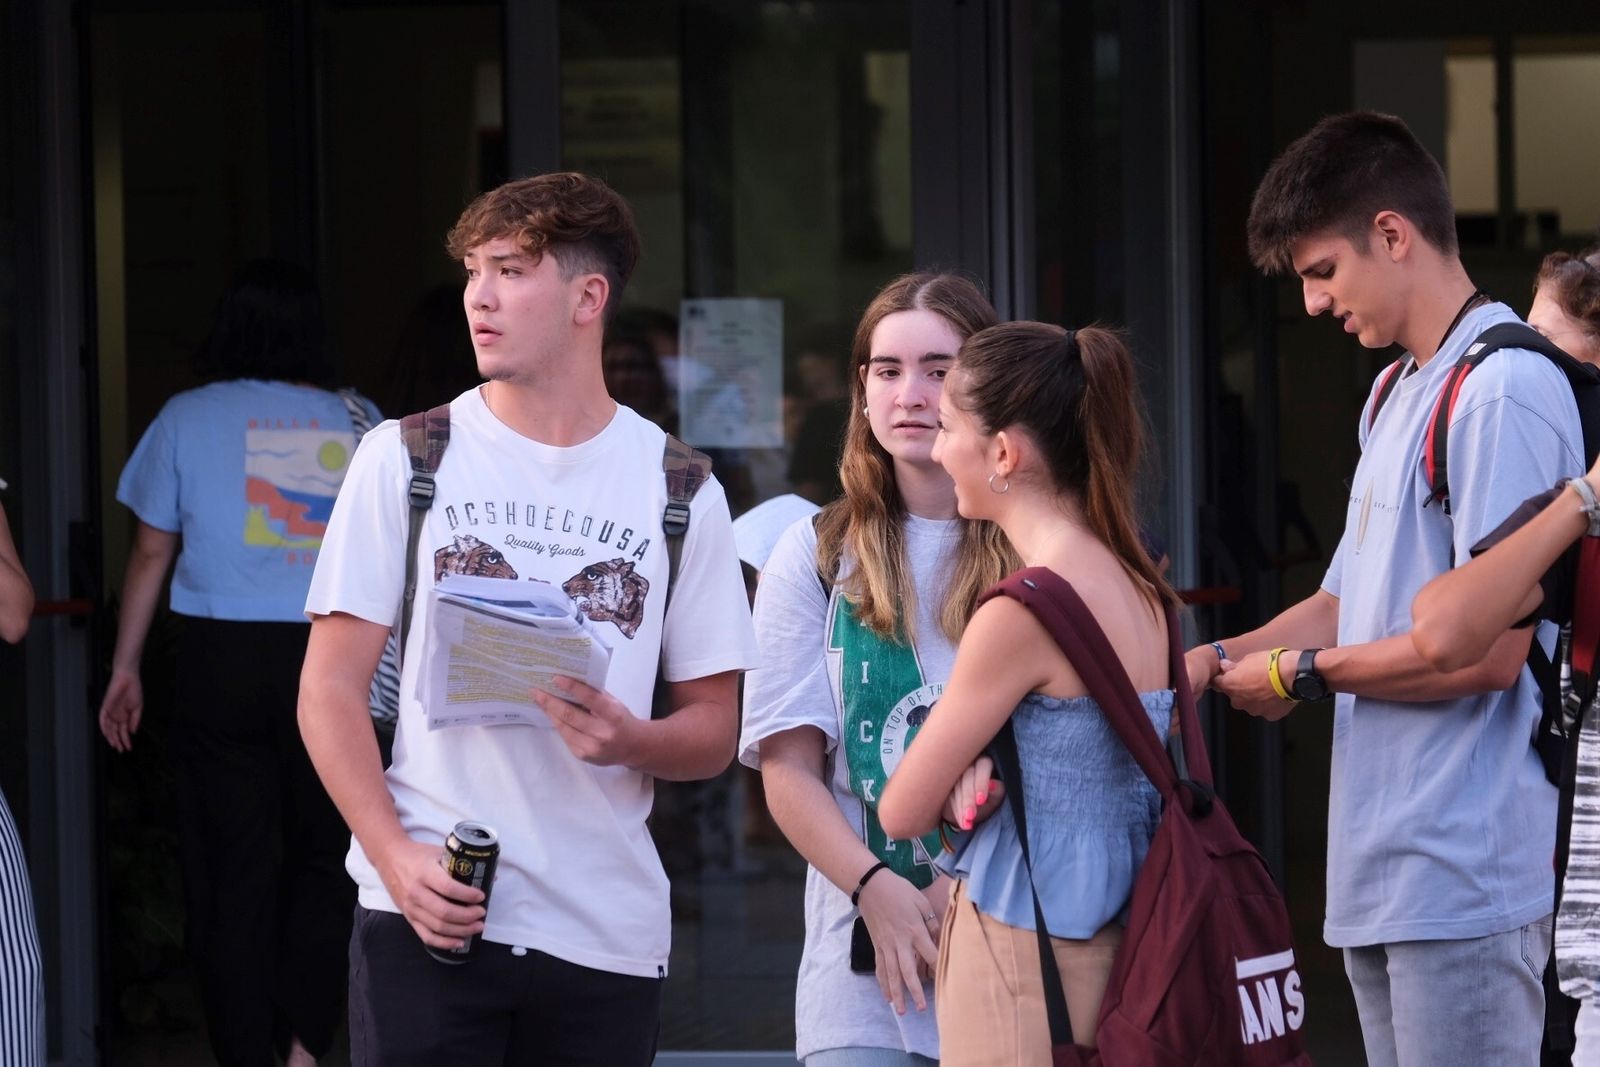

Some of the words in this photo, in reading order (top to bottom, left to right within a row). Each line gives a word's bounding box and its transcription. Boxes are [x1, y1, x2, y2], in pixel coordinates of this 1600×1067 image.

[504, 534, 546, 555] Quality
[548, 543, 587, 558] Goods
[907, 691, 923, 706] OF
[929, 684, 943, 697] TH
[886, 706, 905, 730] TOP
[882, 738, 894, 755] ON
[1234, 949, 1305, 1045] ANS
